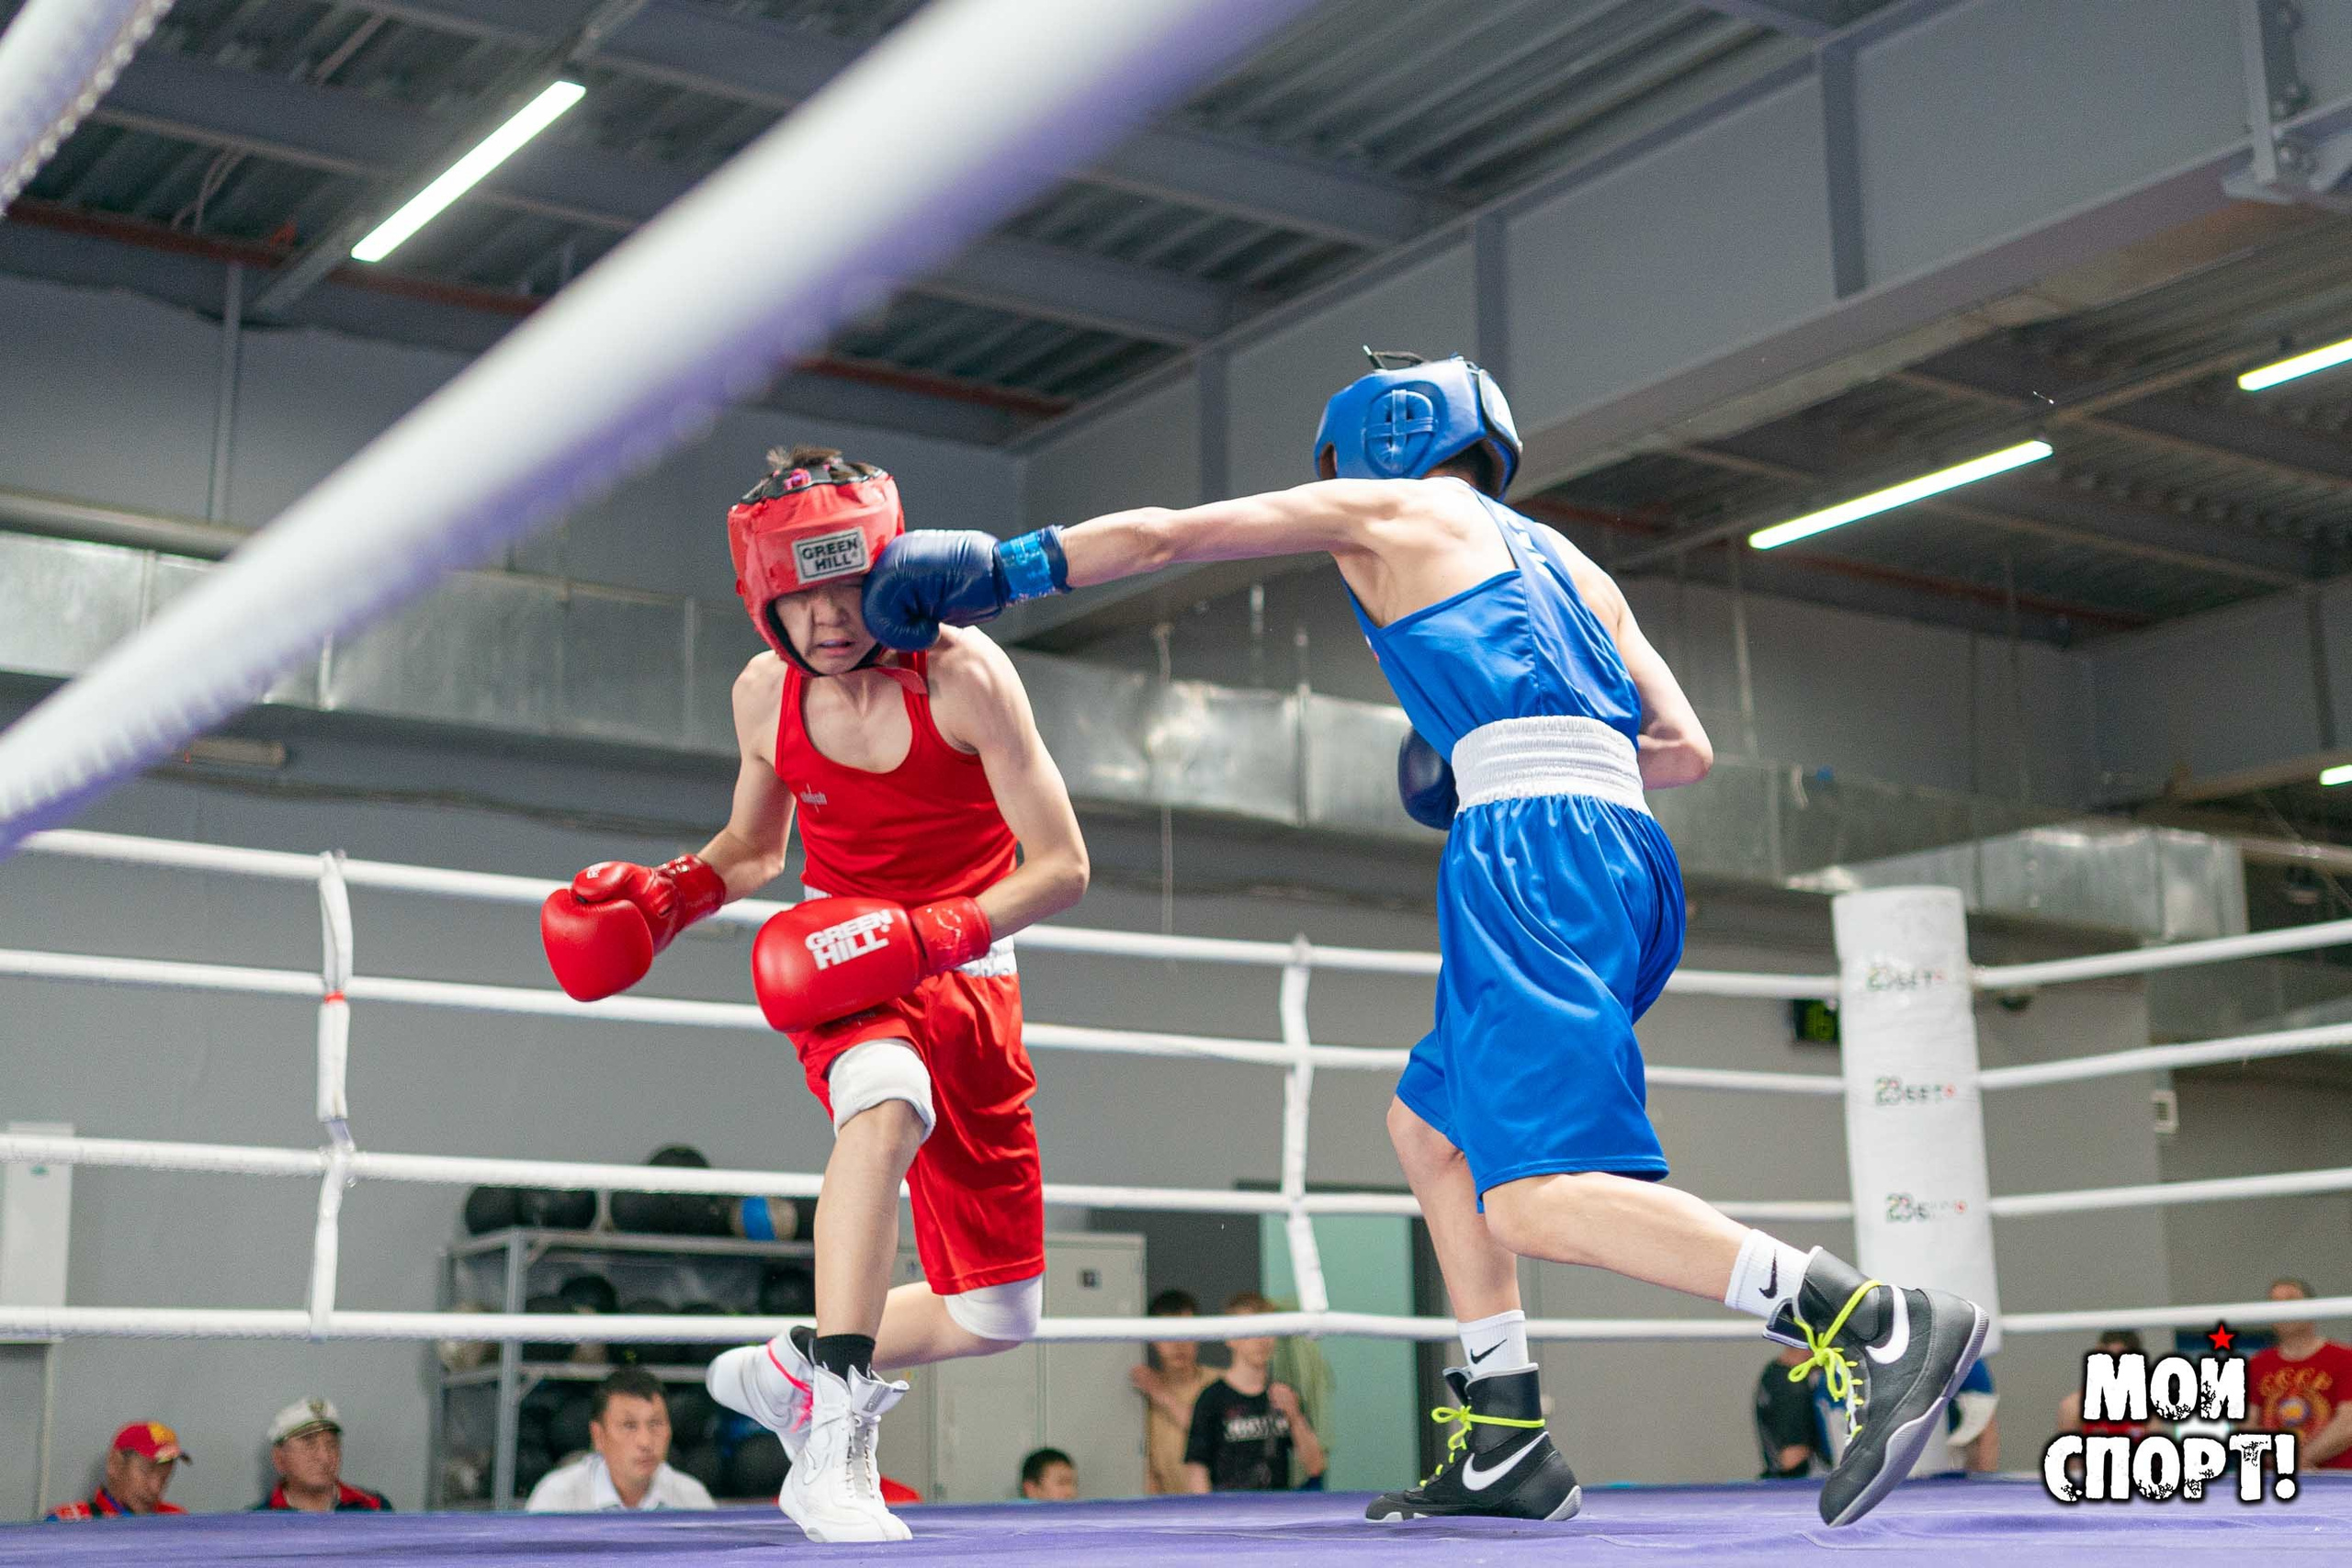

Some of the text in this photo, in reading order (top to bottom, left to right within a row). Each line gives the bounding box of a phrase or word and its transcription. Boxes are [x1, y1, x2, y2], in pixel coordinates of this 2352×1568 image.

[802, 537, 858, 560] GREEN
[815, 553, 852, 571] HILL
[805, 908, 894, 951] GREEN
[812, 930, 889, 971] HILL
